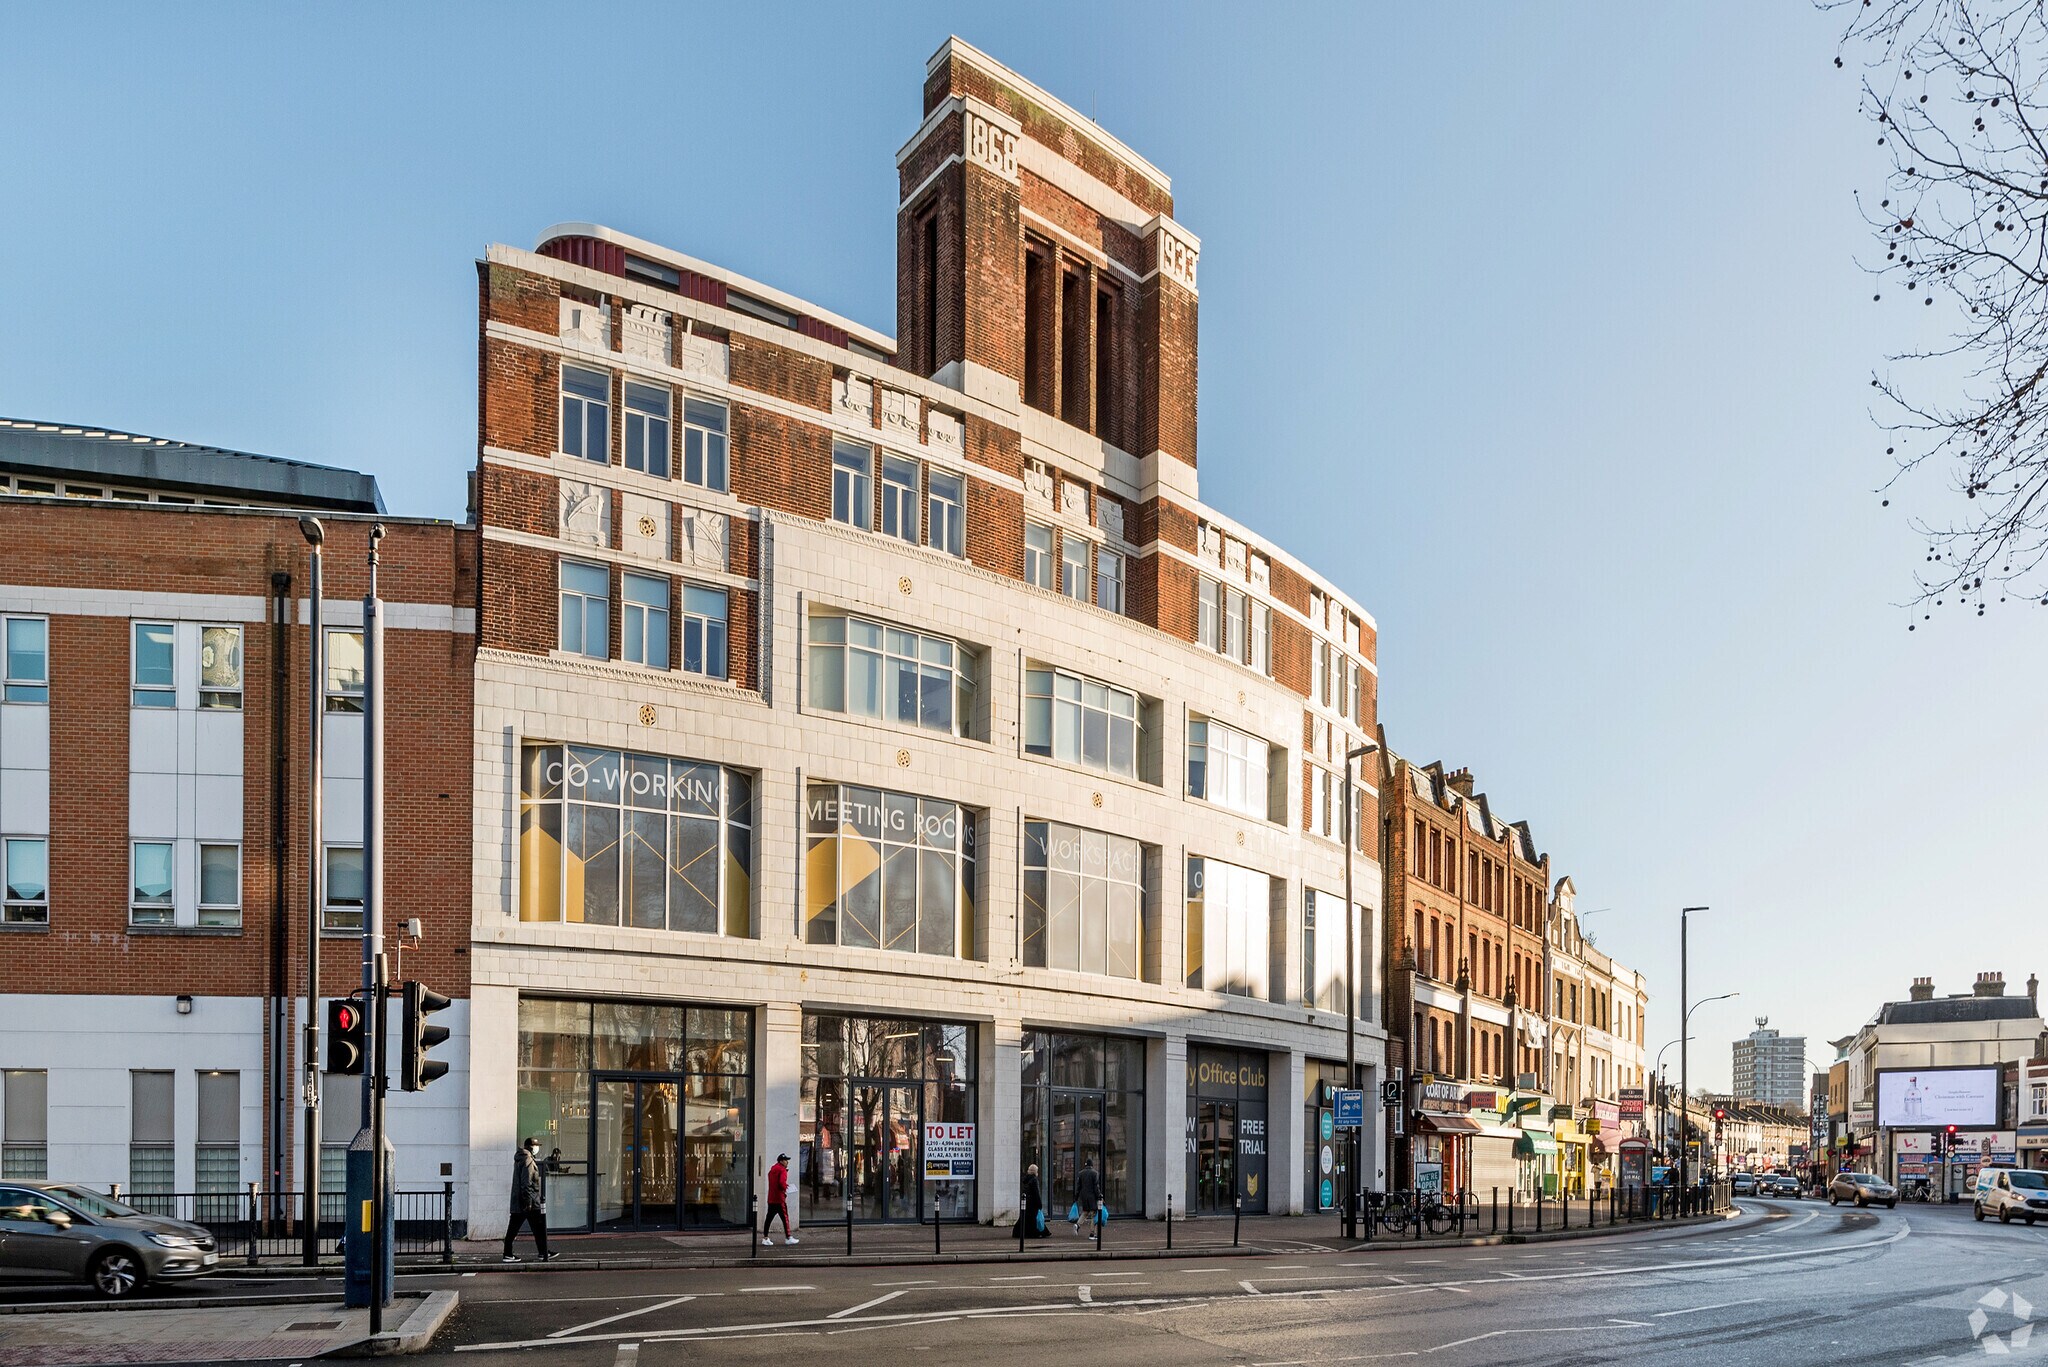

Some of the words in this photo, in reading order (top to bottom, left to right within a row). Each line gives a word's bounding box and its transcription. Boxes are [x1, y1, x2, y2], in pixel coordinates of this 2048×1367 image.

[967, 112, 1018, 181] 1868
[1160, 228, 1197, 288] 1933
[806, 800, 904, 831] MEETING
[1199, 1062, 1237, 1085] Office
[1239, 1066, 1266, 1088] Club
[1426, 1085, 1441, 1098] COAT
[1441, 1085, 1450, 1099] OF
[927, 1126, 944, 1138] TO
[949, 1126, 973, 1138] LET
[1241, 1119, 1265, 1135] FREE
[1240, 1140, 1266, 1155] TRIAL
[1420, 1172, 1438, 1182] WE'RE
[1422, 1180, 1437, 1190] OPEN
